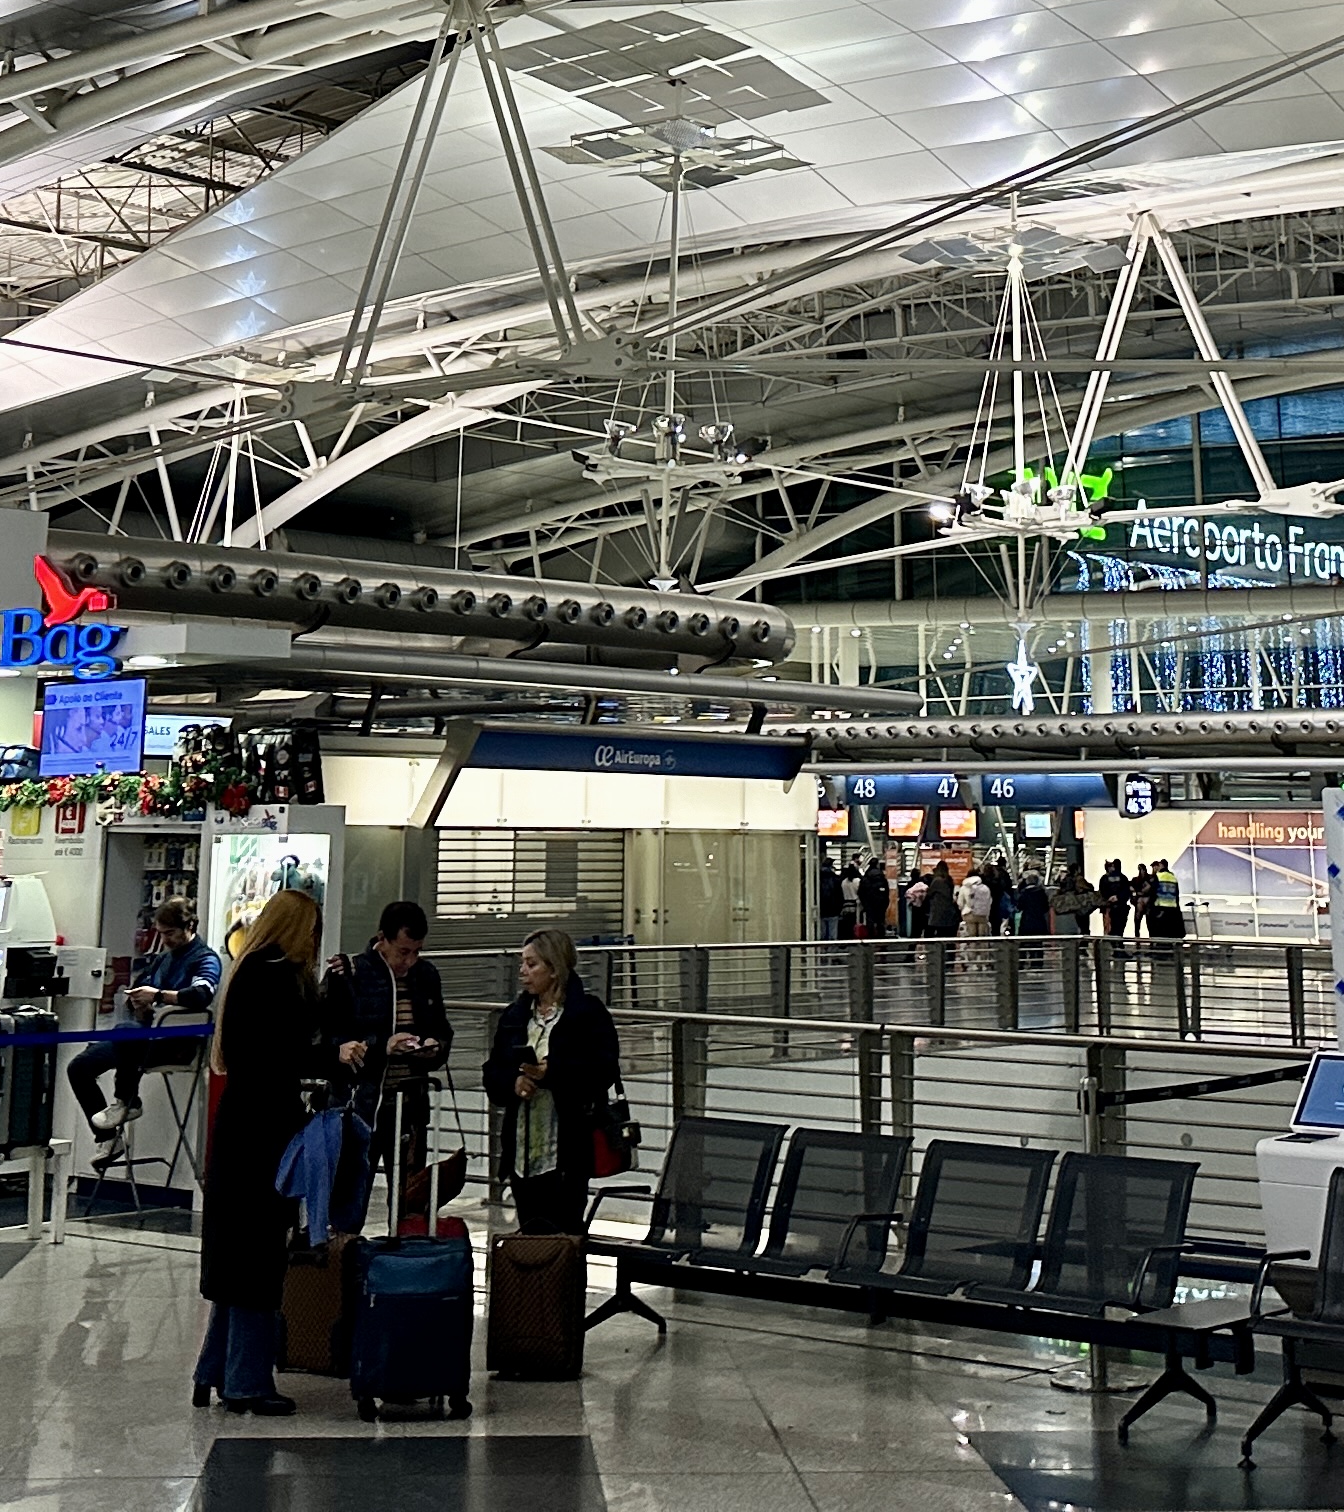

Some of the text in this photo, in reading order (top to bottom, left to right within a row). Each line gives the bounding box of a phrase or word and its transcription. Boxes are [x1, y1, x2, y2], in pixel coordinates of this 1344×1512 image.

[854, 778, 875, 798] 48
[937, 778, 958, 798] 47
[990, 778, 1014, 798] 46
[1218, 822, 1284, 842] handling
[1287, 825, 1324, 843] your
